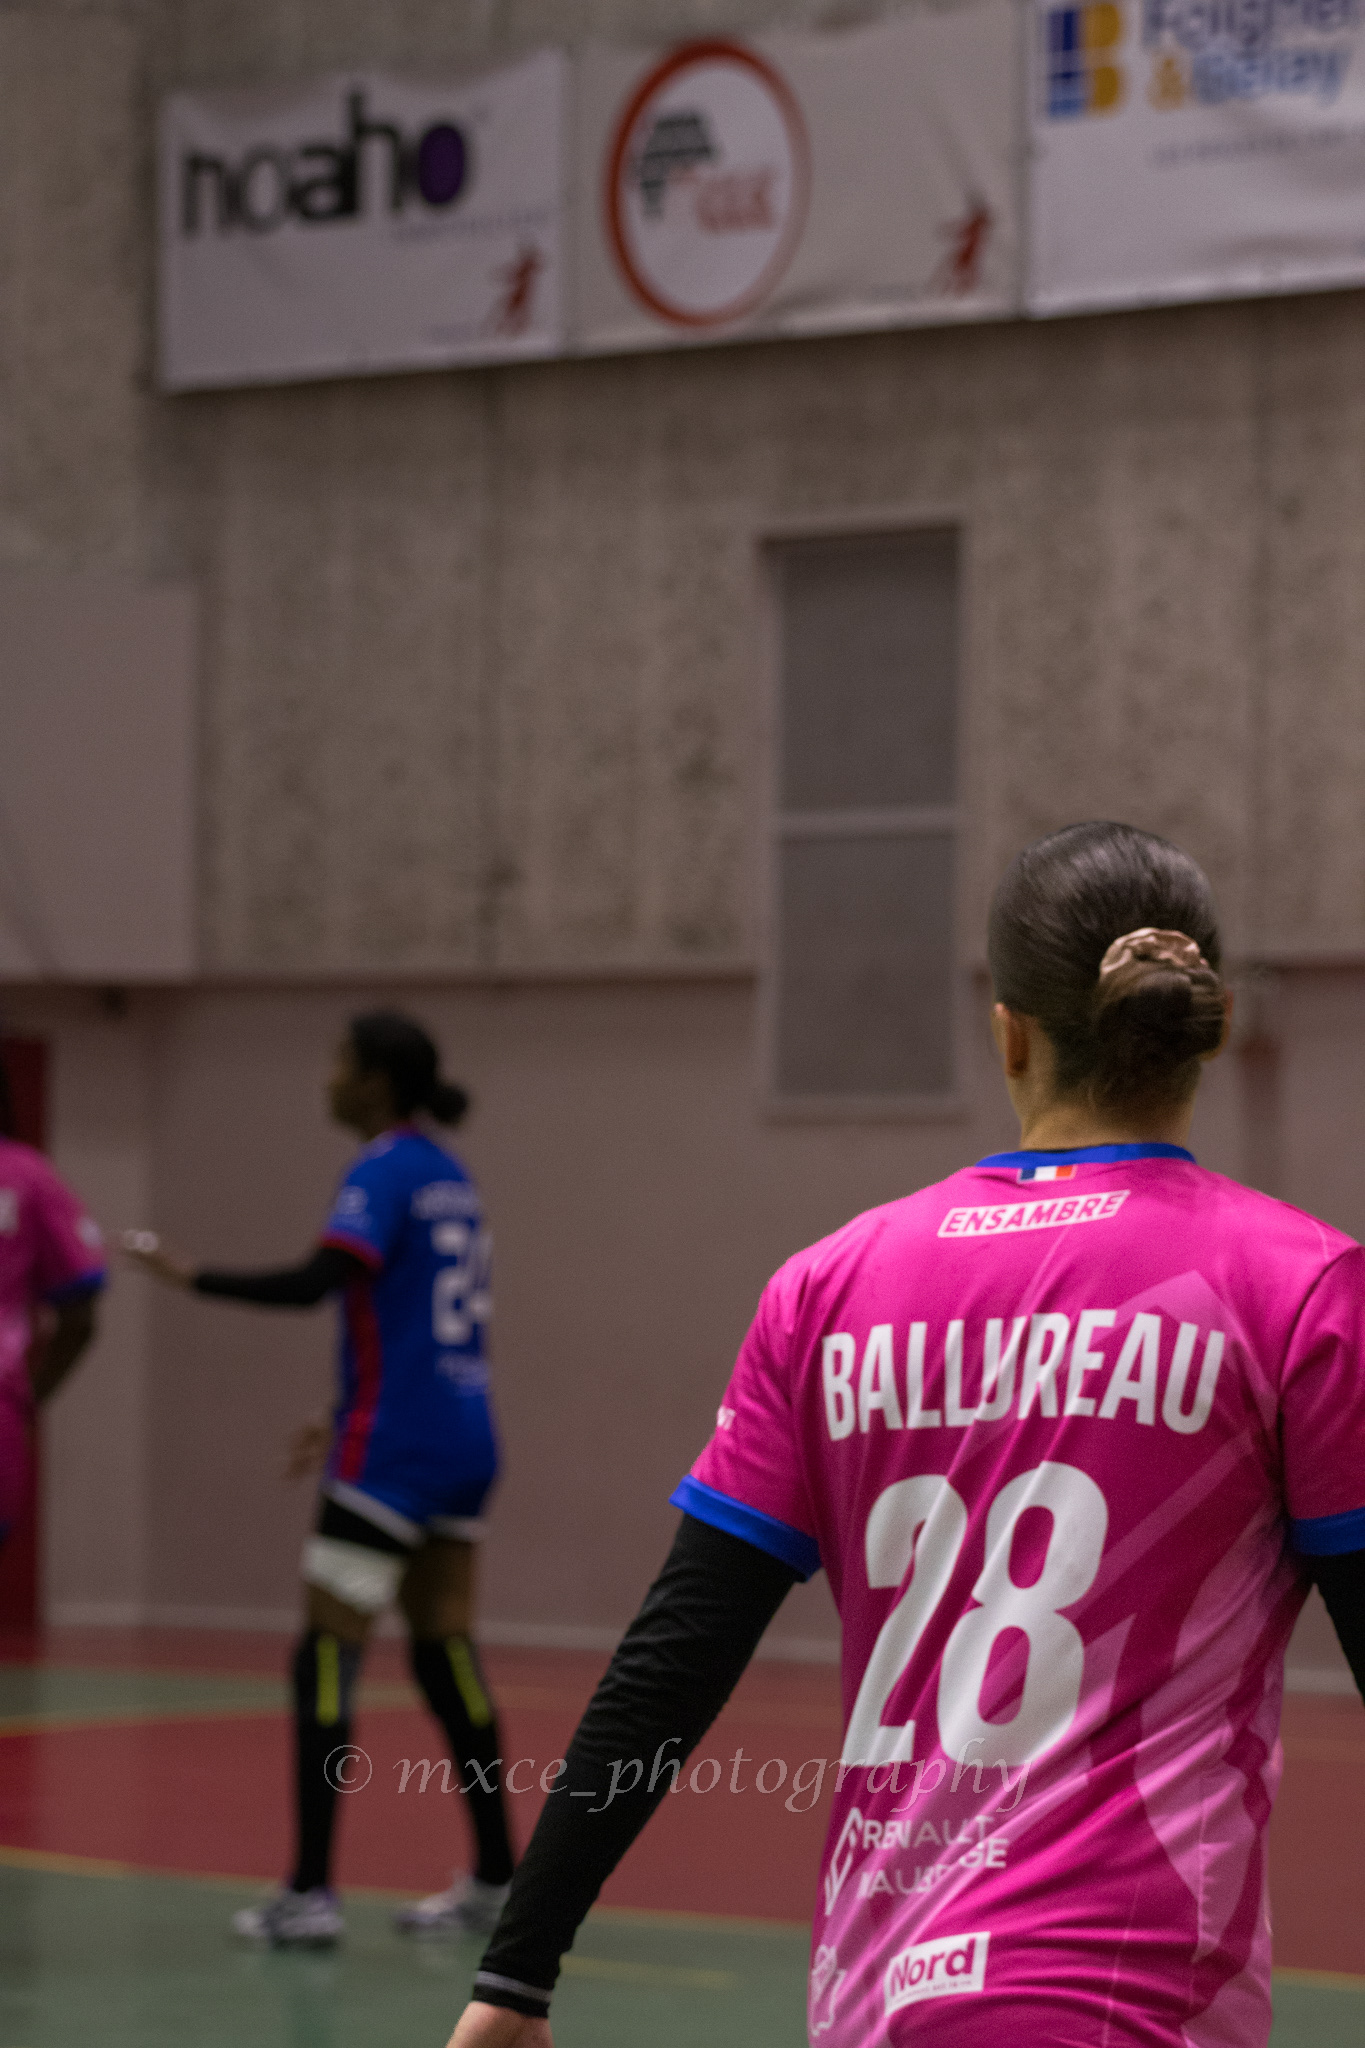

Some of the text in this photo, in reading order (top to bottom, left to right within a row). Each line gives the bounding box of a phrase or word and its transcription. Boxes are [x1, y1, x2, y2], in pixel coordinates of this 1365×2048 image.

[182, 86, 472, 237] noaho
[943, 1195, 1123, 1233] ENSAMBRE
[822, 1309, 1226, 1441] BALLUREAU
[841, 1460, 1109, 1767] 28
[890, 1937, 977, 1996] Nord
